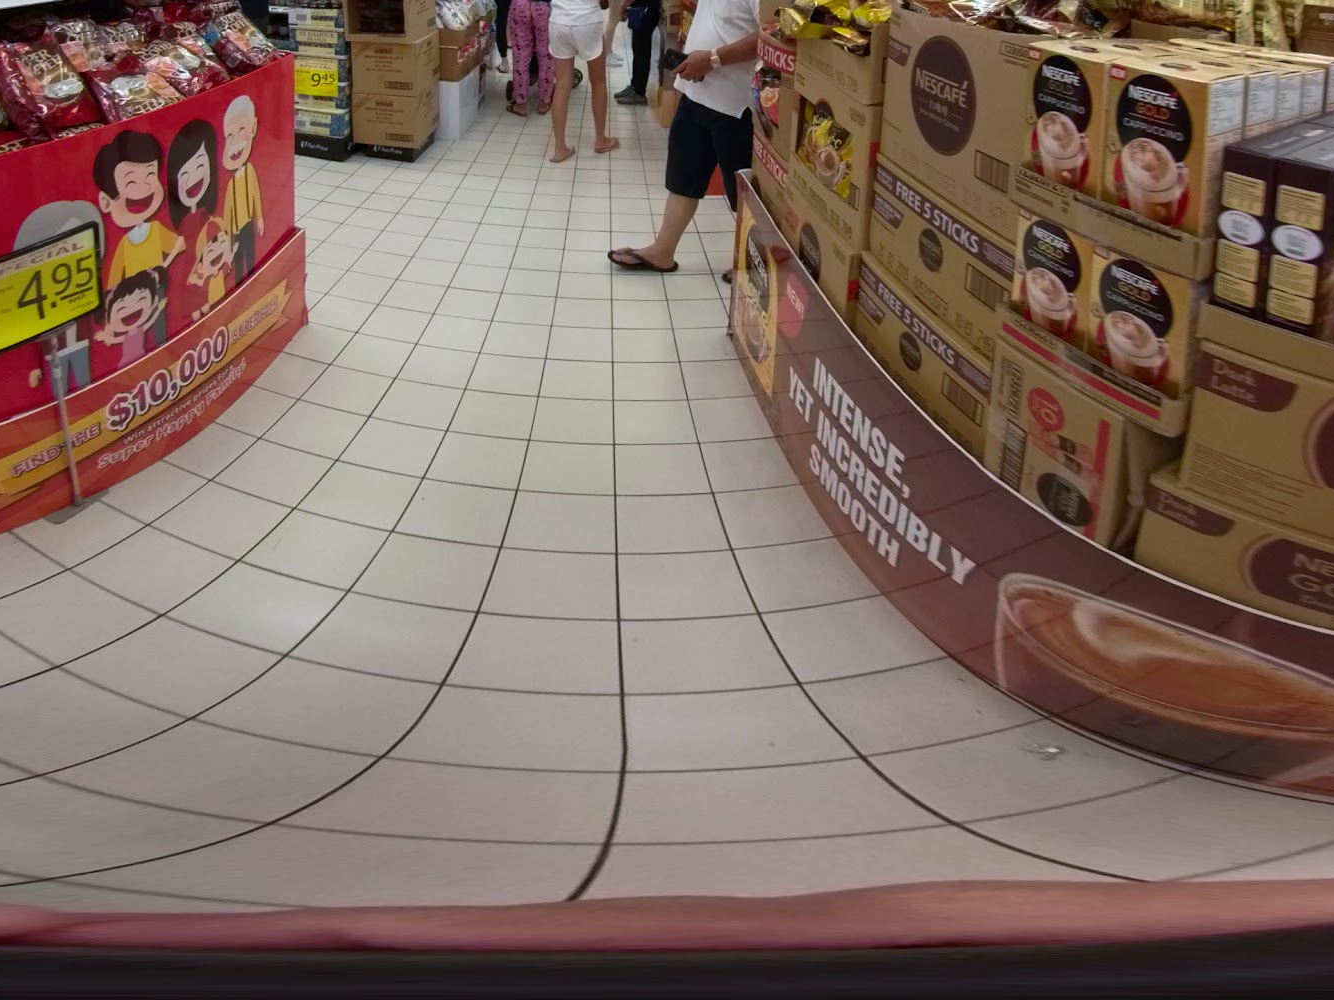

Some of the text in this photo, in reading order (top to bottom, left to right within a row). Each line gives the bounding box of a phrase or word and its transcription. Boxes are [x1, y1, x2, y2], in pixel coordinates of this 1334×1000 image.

[311, 73, 335, 87] 9.45
[915, 67, 968, 109] NESCAFÉ
[1037, 93, 1085, 115] CAPPUCCINO
[1135, 101, 1170, 120] GOLD
[1122, 117, 1184, 141] CAPPUCCINO
[895, 180, 922, 213] FREE
[923, 202, 931, 219] 5
[932, 209, 979, 253] STICKS
[1037, 241, 1064, 259] GOLD
[17, 254, 93, 320] 4.95
[786, 280, 804, 319] NEW!
[1118, 281, 1152, 301] GOLD
[877, 282, 955, 365] FREE 5 STICKS
[1210, 358, 1257, 387] Dark
[1210, 379, 1257, 402] Latte
[10, 311, 257, 478] FIND $10,000 SUPER
[123, 380, 217, 444] Win attractive prizes
[97, 433, 155, 469] Super
[156, 402, 206, 441] Happy
[813, 356, 910, 499] INTENSE,
[788, 365, 976, 586] YET INCREDIBLY
[809, 443, 900, 568] SMOOTH
